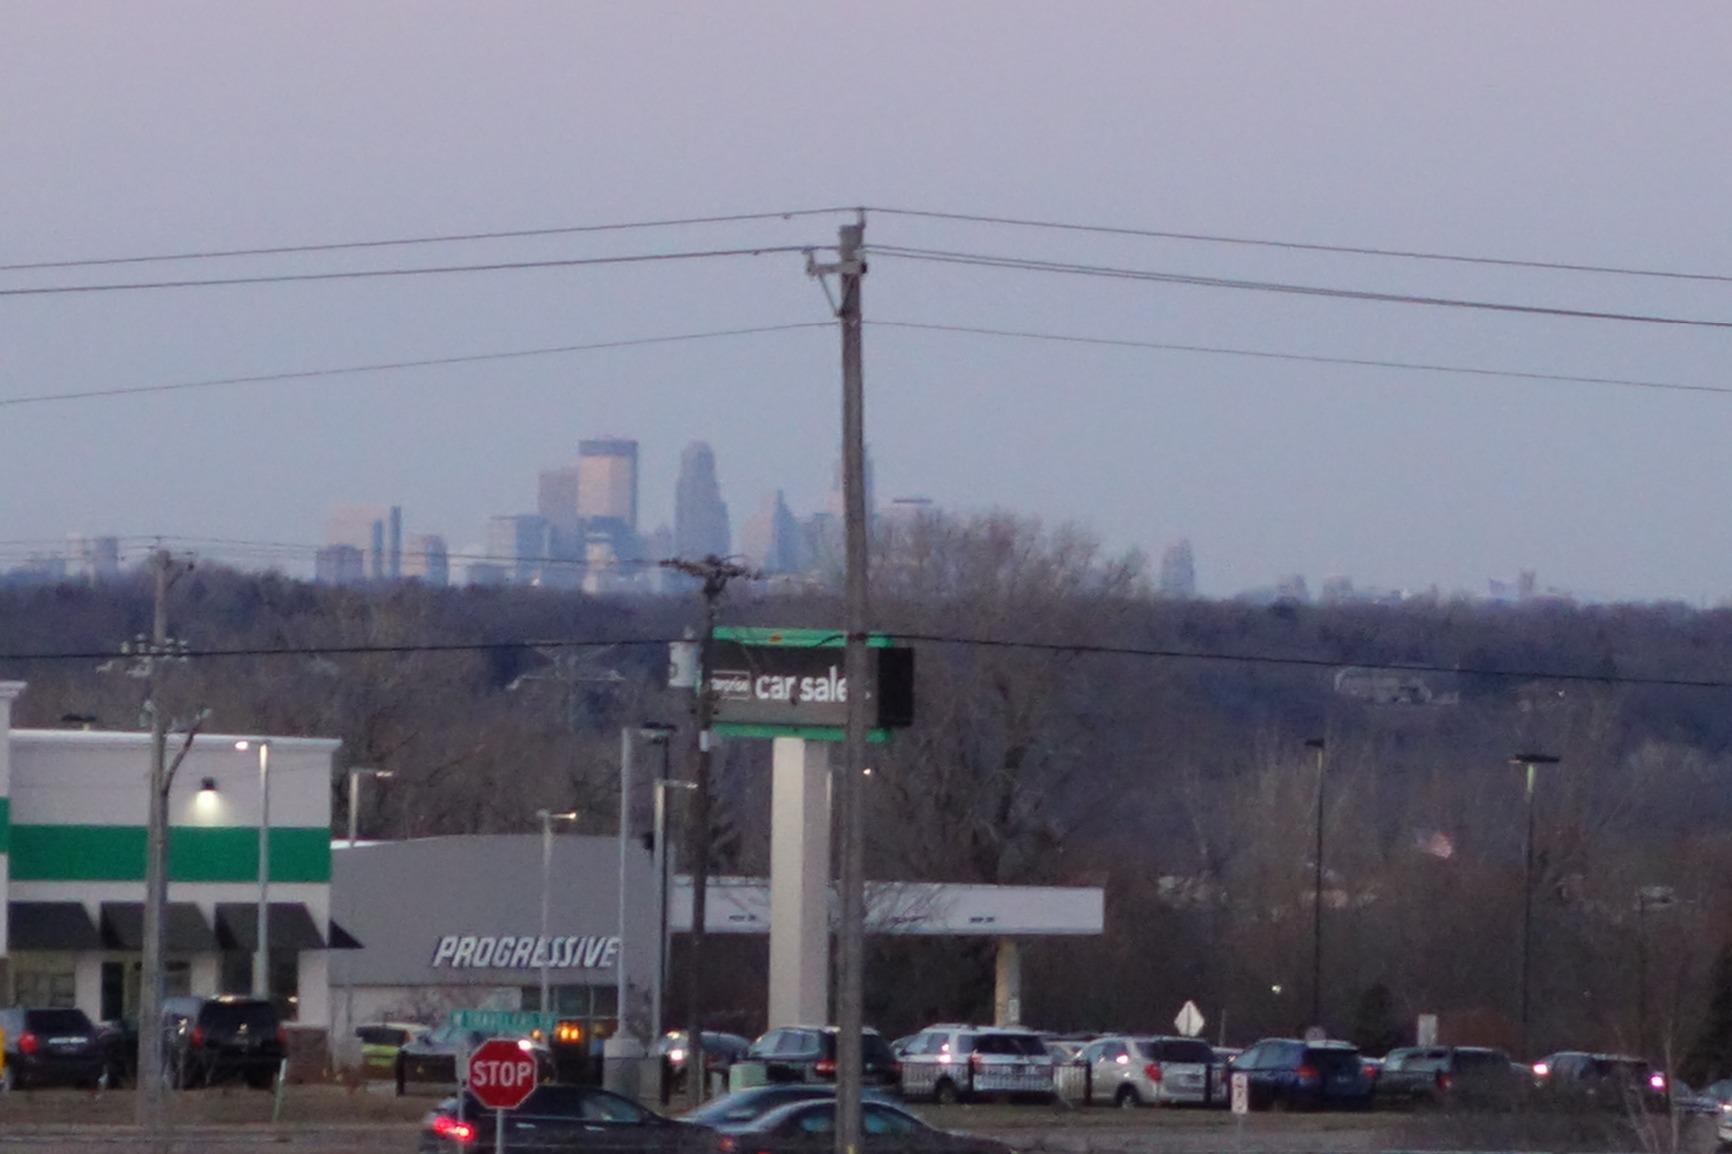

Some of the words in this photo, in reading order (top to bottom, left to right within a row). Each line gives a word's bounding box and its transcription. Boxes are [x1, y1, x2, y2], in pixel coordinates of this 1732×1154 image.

[756, 674, 796, 699] car
[433, 935, 621, 968] PROGRESSIVE
[472, 1060, 531, 1087] STOP
